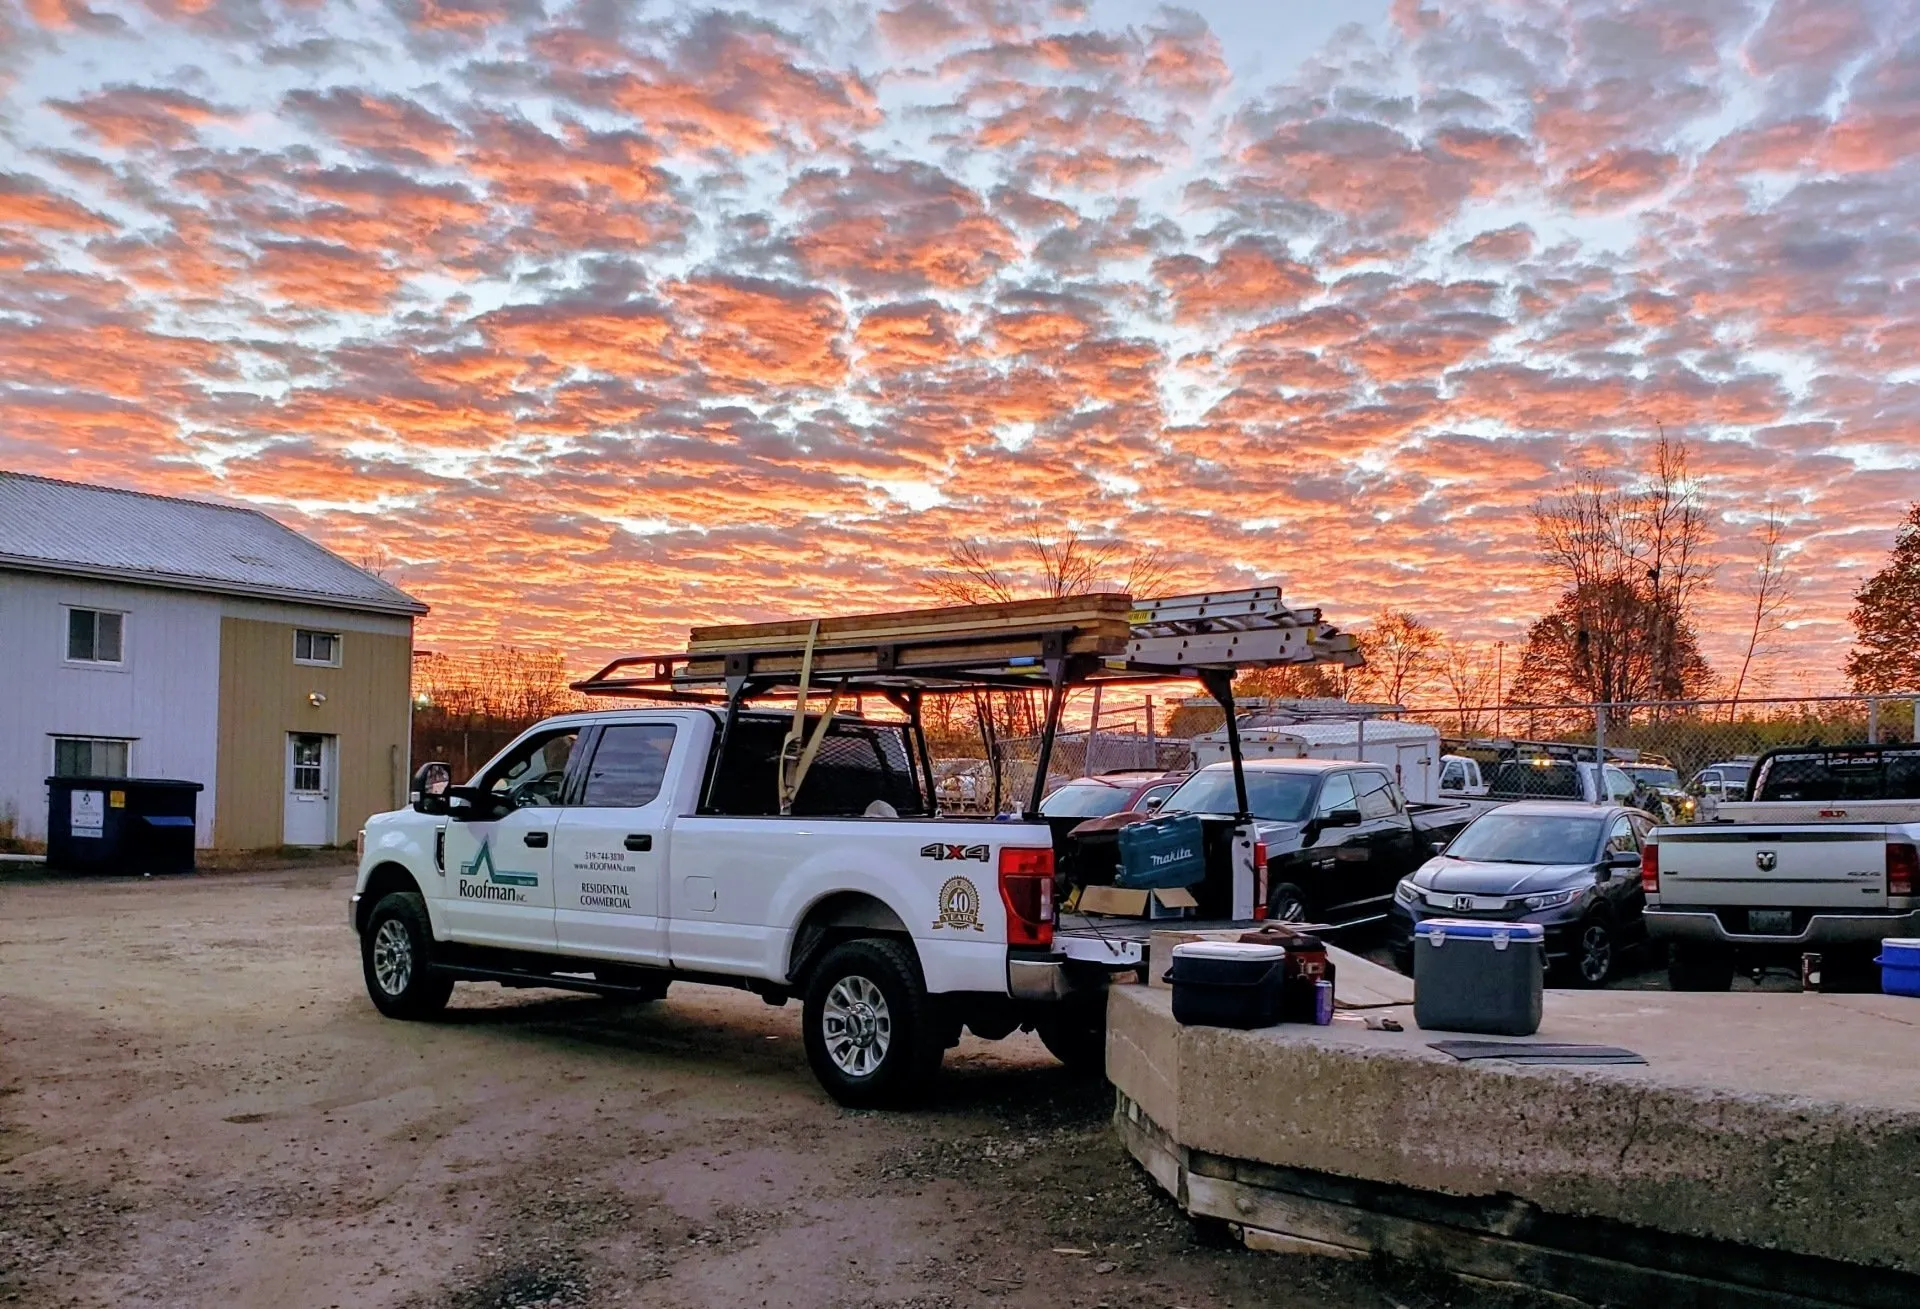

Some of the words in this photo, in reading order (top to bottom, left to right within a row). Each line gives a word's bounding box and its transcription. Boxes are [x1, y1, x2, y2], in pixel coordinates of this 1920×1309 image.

[459, 879, 516, 902] Roofman
[581, 882, 629, 896] RESIDENTIAL
[580, 895, 632, 909] COMMERCIAL
[948, 892, 969, 913] 40
[942, 913, 974, 923] YEARS
